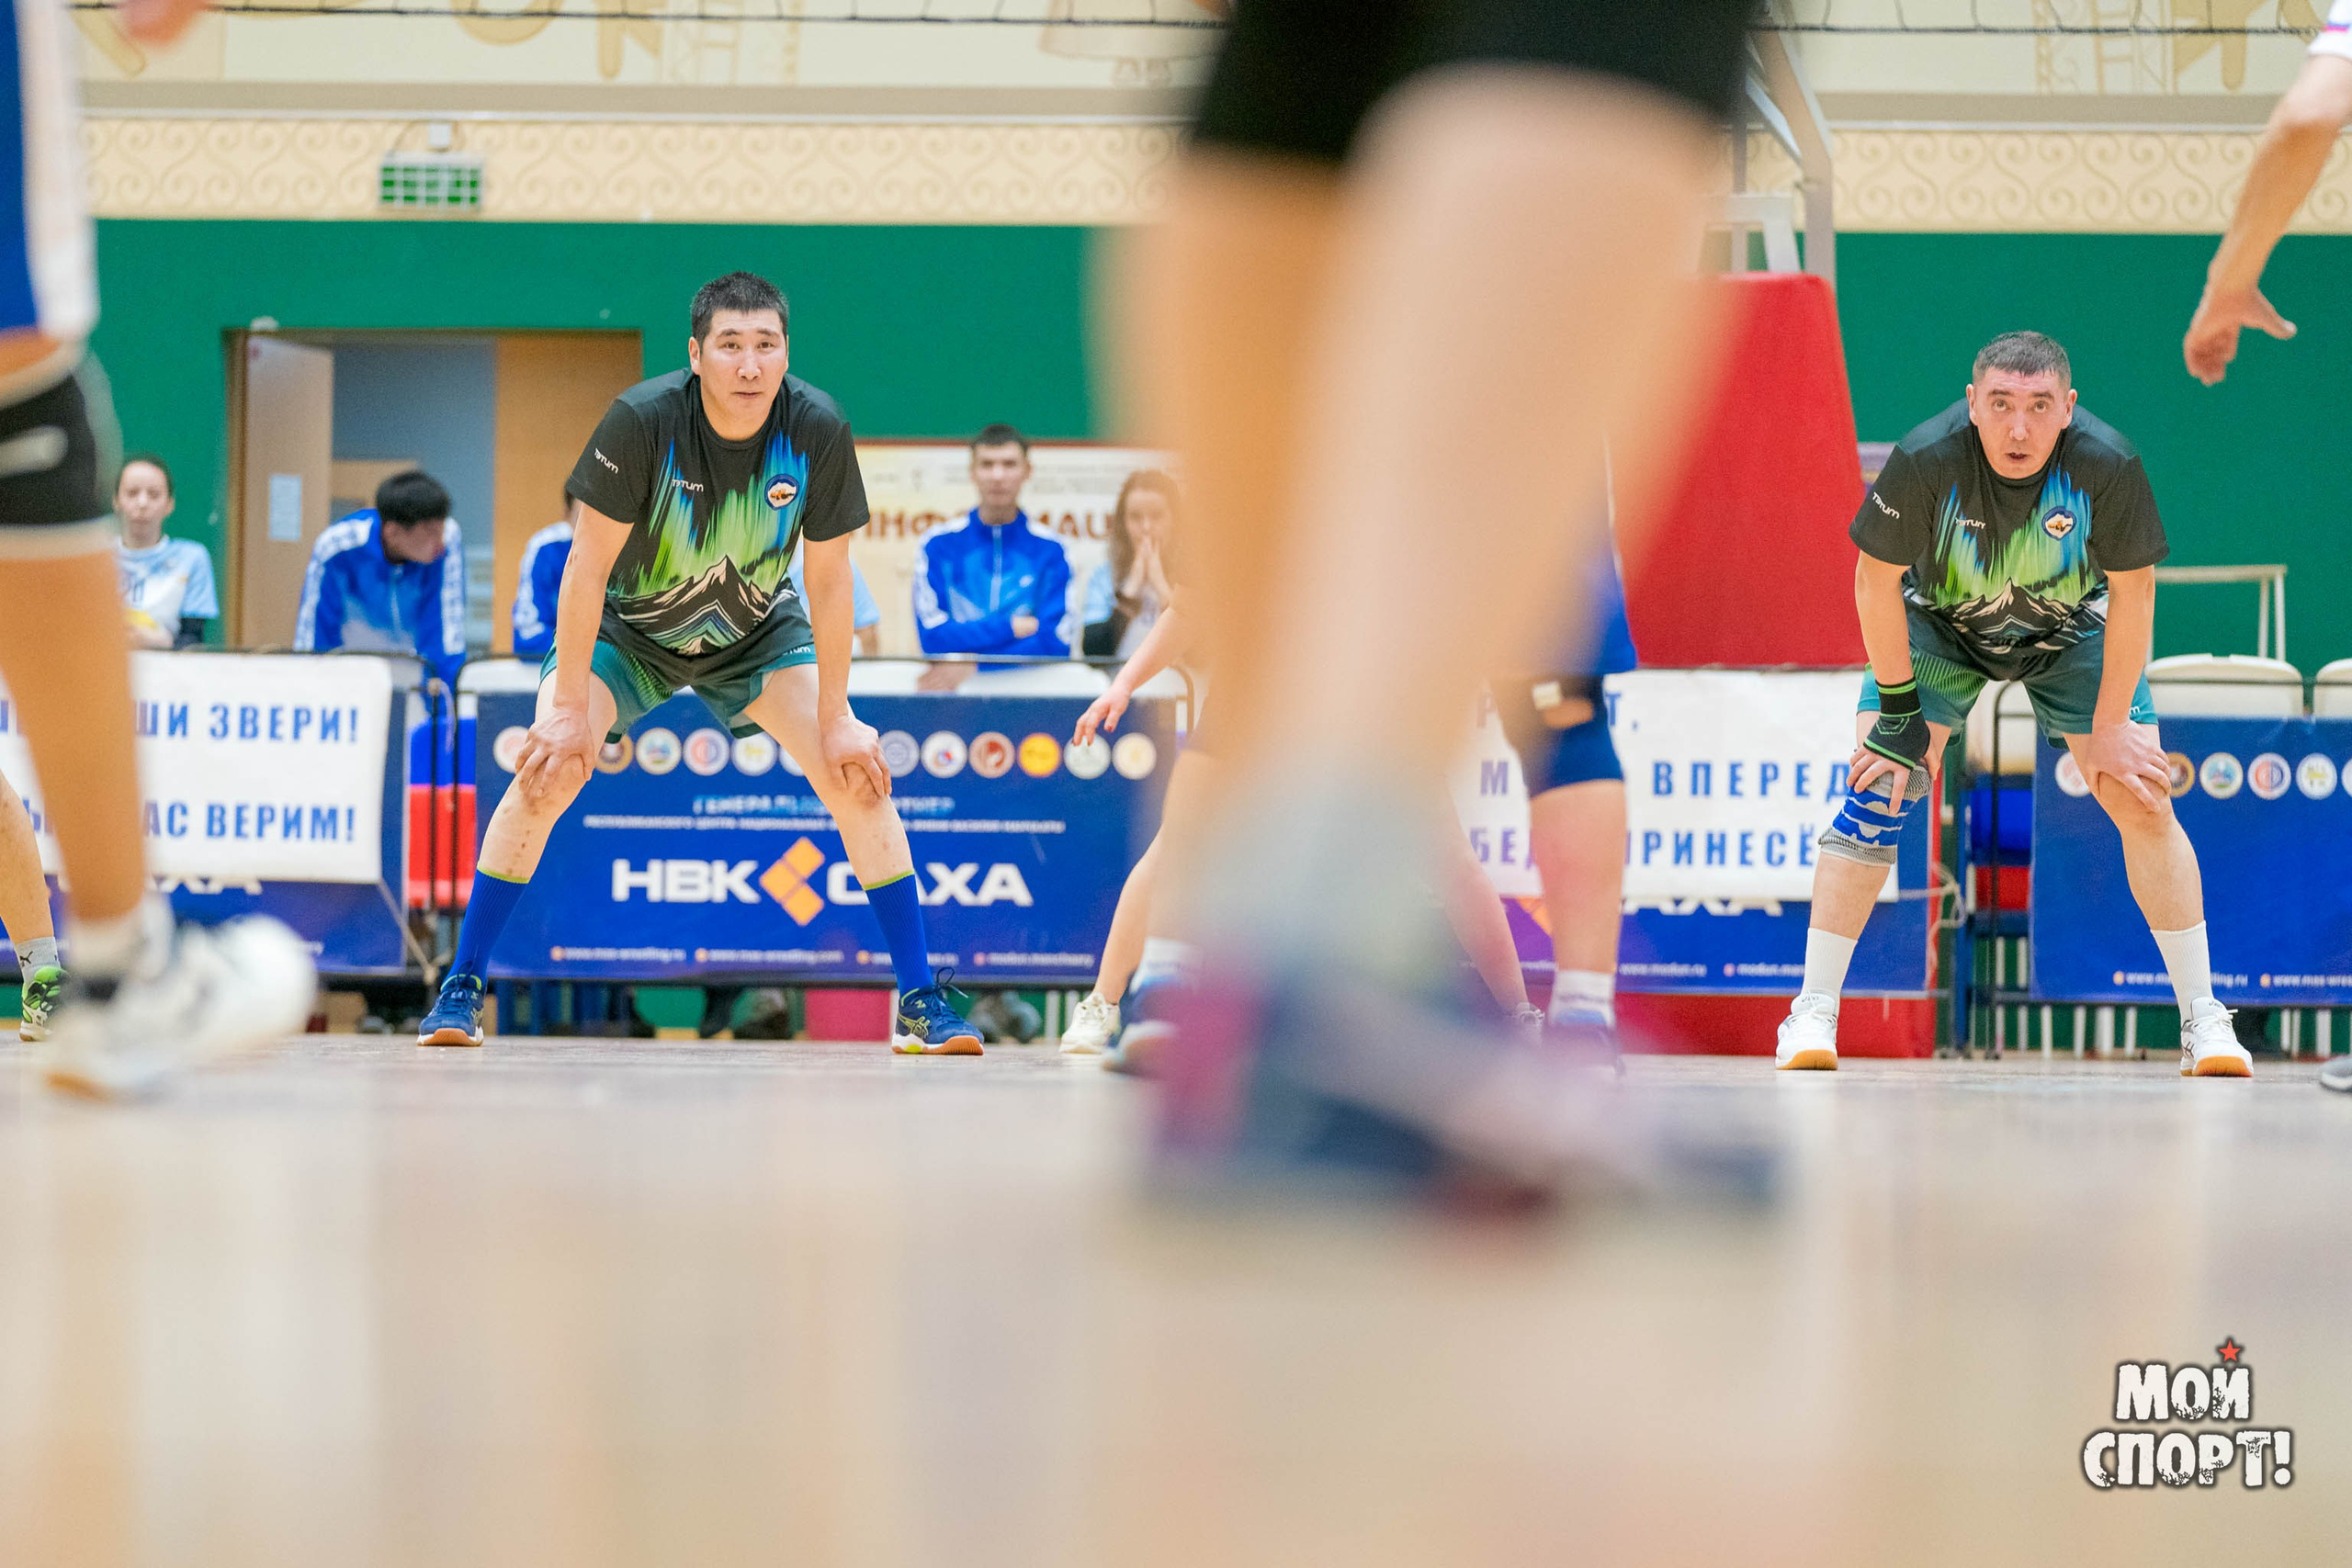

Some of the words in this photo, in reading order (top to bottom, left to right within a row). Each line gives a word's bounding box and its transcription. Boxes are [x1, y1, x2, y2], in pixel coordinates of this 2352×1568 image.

[209, 704, 358, 743] ЗВЕРИ!
[207, 803, 356, 842] ВЕРИМ!
[612, 858, 762, 903] НВК
[827, 861, 1034, 907] СХА
